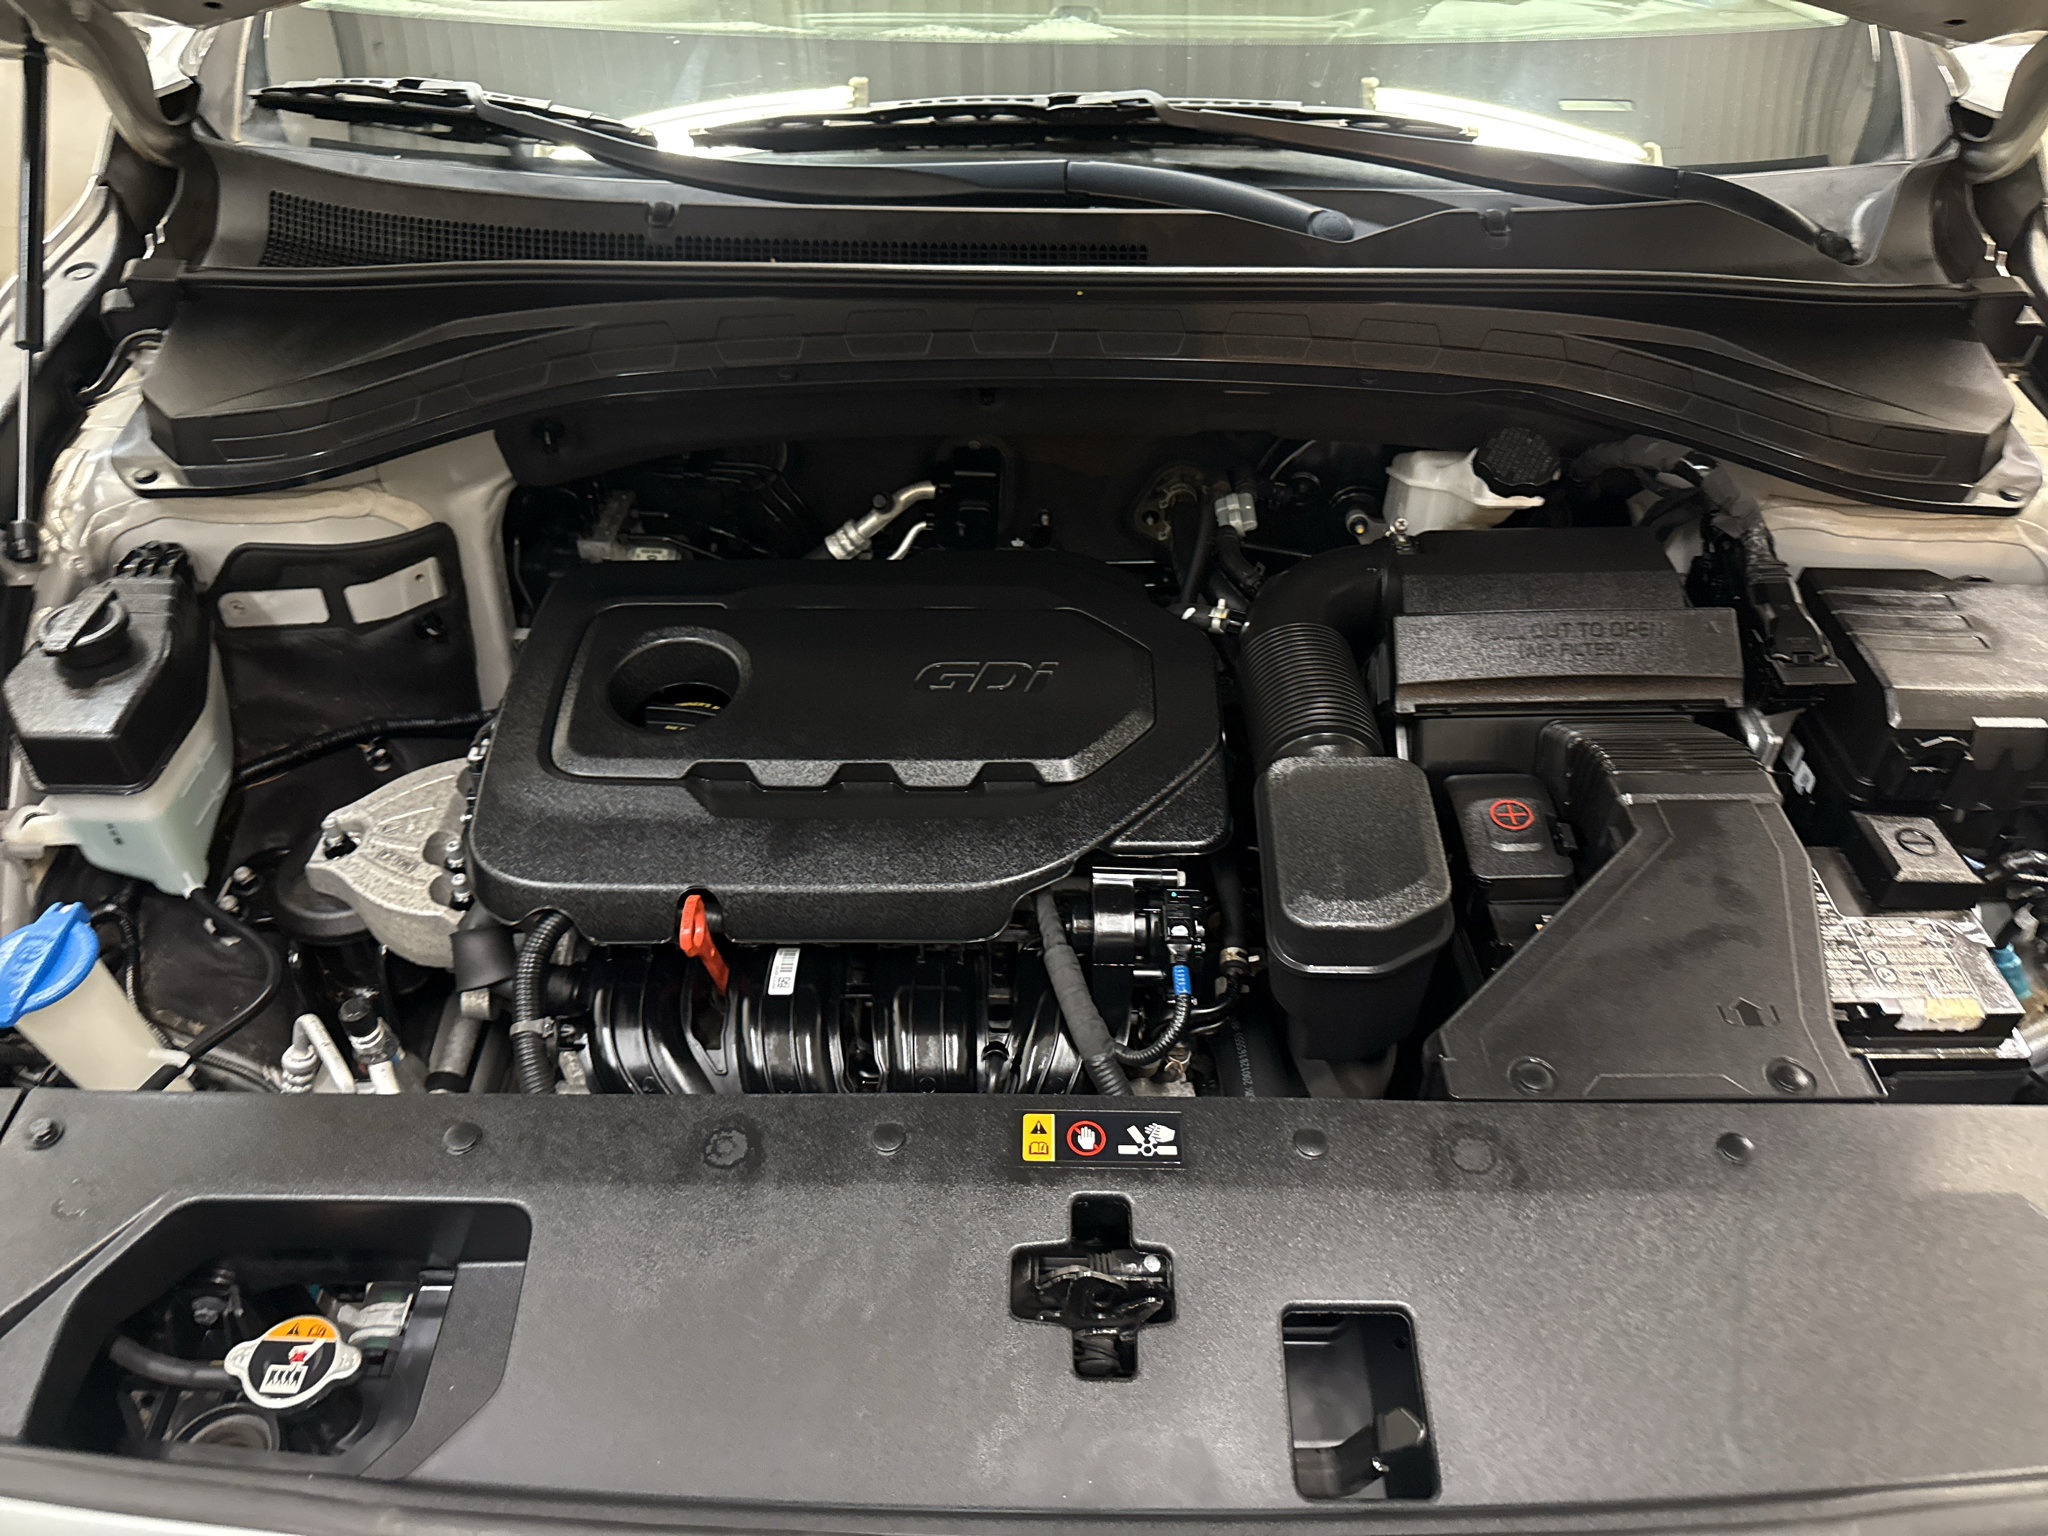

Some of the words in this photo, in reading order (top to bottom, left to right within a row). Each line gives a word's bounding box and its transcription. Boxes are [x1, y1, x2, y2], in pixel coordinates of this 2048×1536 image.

[1531, 621, 1572, 638] OUT
[1576, 620, 1605, 638] TO
[1610, 620, 1665, 638] OPEN
[914, 660, 1060, 693] GDi
